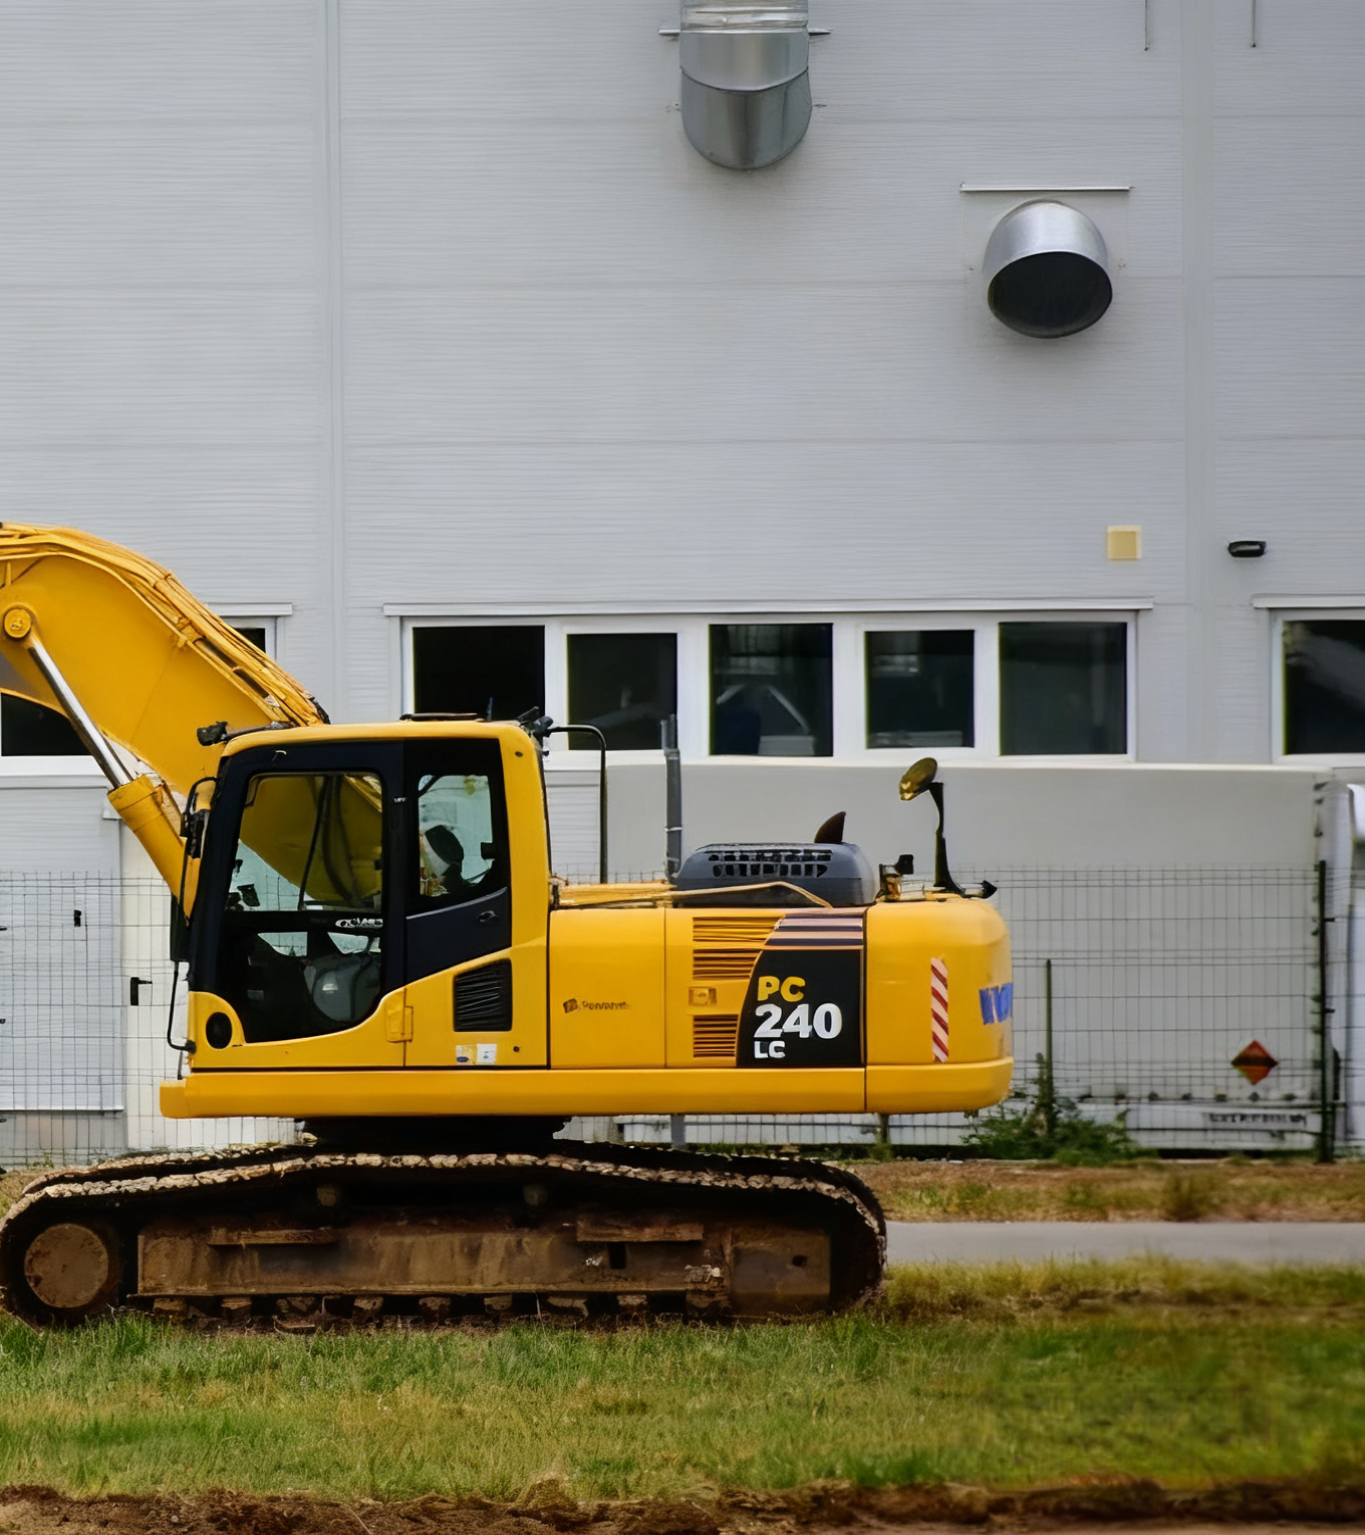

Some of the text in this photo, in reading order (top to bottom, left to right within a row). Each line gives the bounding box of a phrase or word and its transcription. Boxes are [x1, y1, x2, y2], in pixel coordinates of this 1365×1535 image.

[757, 975, 806, 1002] PC
[753, 1002, 843, 1039] 240
[753, 1040, 786, 1059] LC
